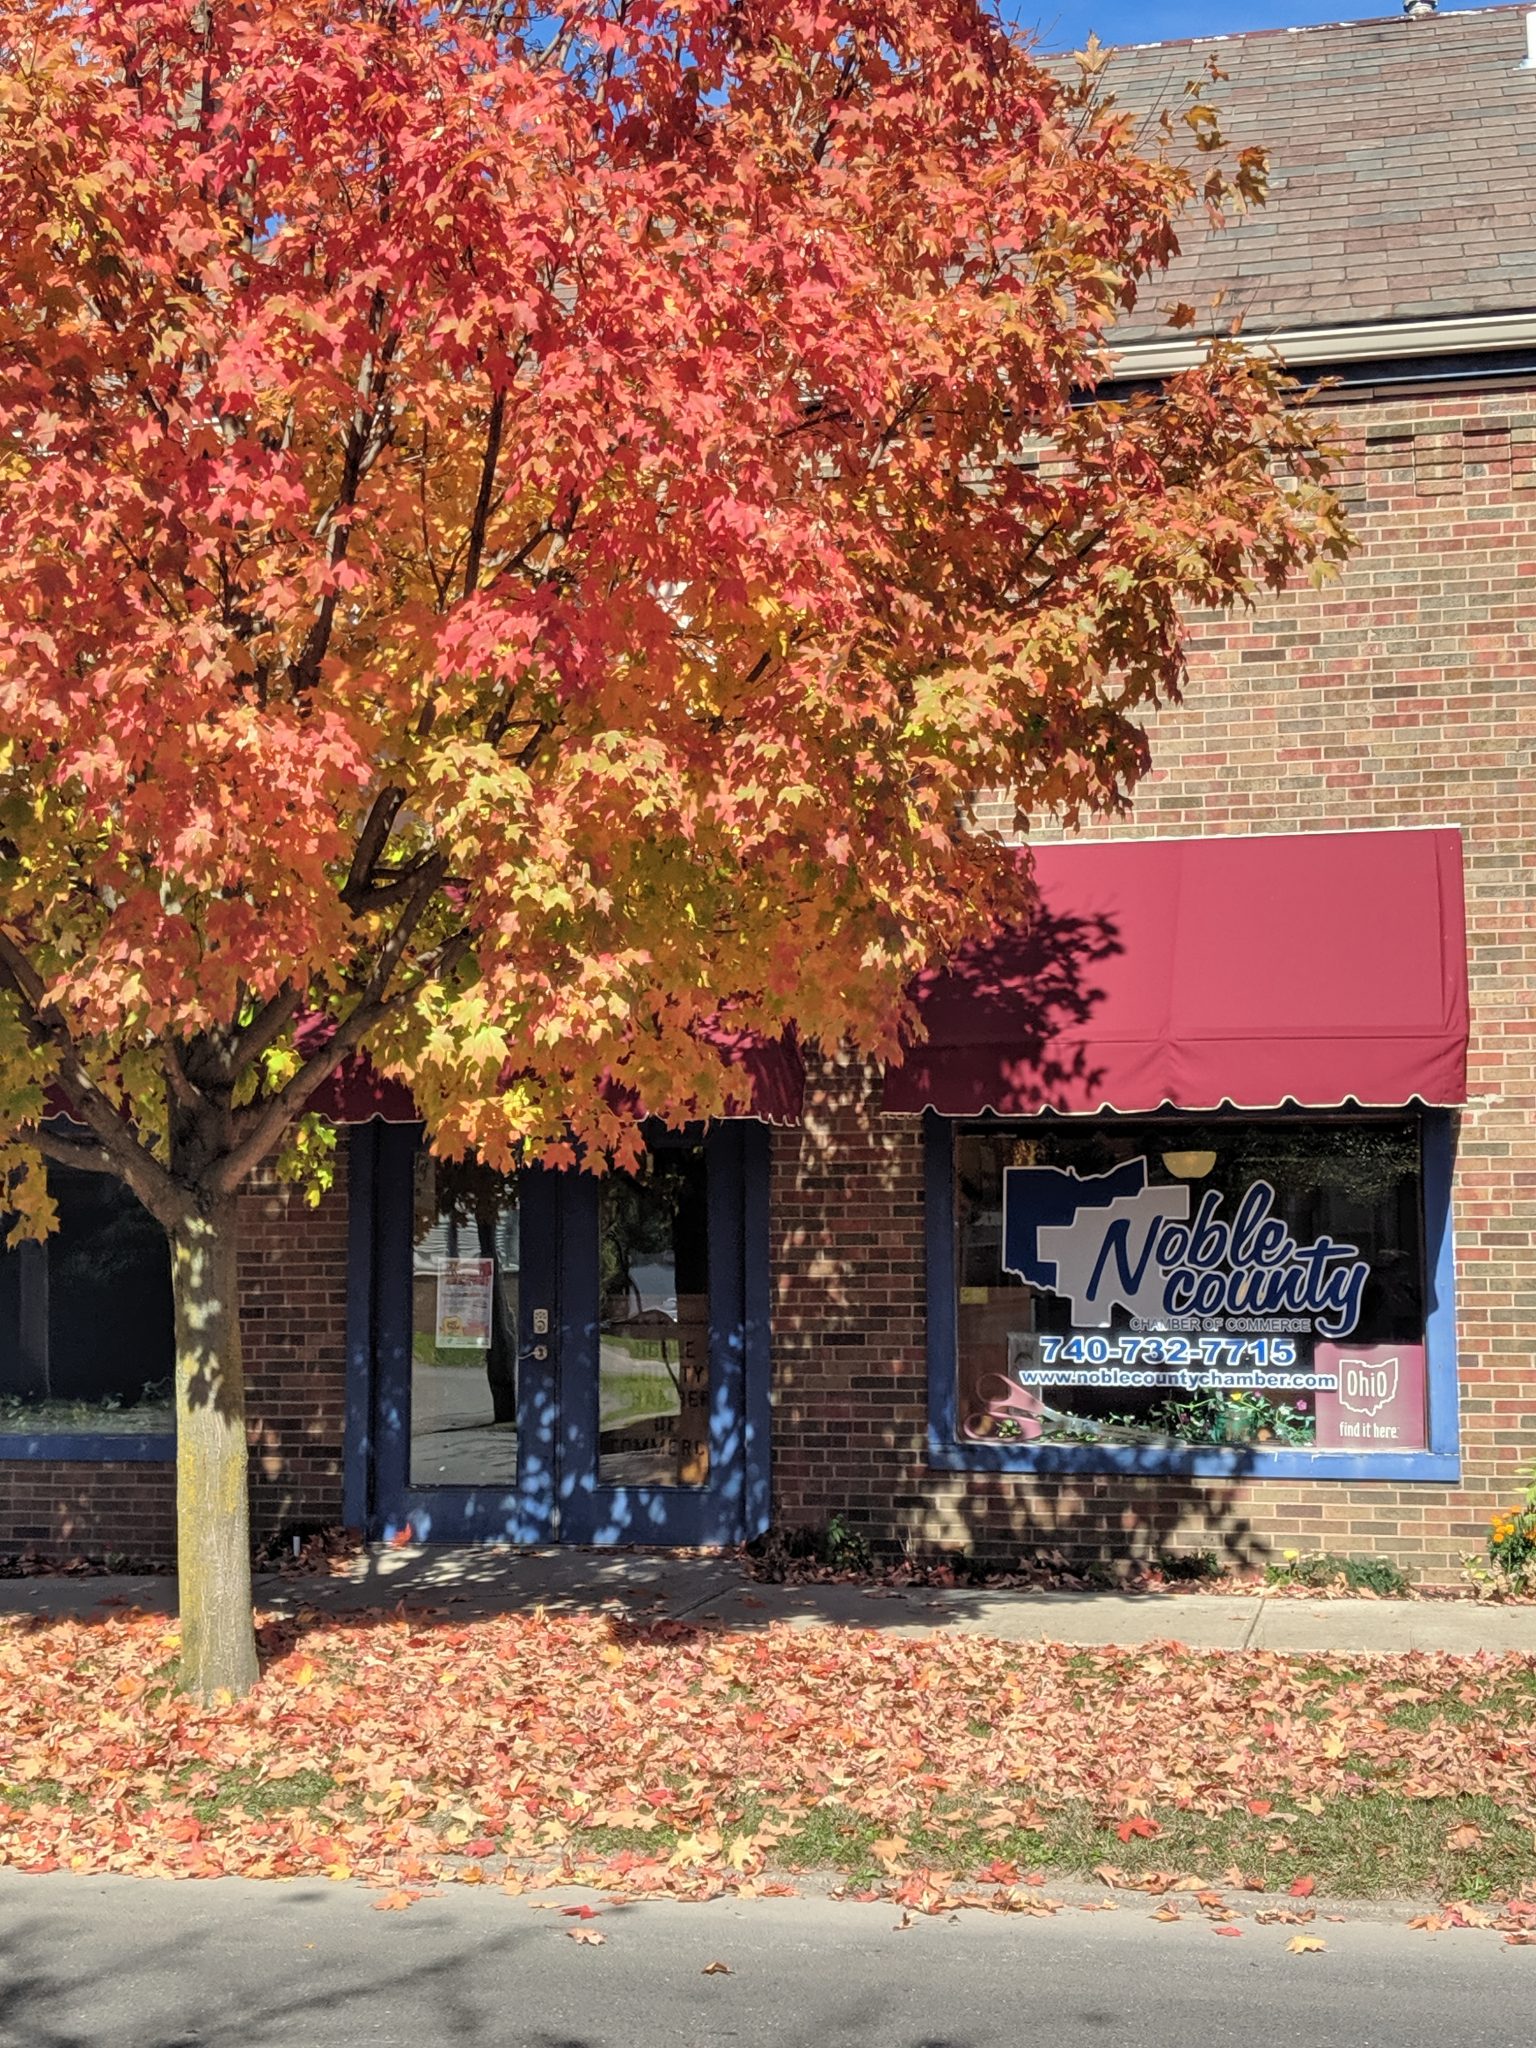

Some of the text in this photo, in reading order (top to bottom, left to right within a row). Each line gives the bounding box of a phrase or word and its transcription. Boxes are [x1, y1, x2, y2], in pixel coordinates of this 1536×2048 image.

[1085, 1179, 1296, 1302] Noble
[1130, 1317, 1312, 1333] CHAMBER OF COMMERCE
[1039, 1336, 1297, 1366] 740-732-7715
[1020, 1369, 1337, 1390] www.noblecountychamber.com
[1340, 1421, 1360, 1437] find
[1362, 1422, 1371, 1438] it
